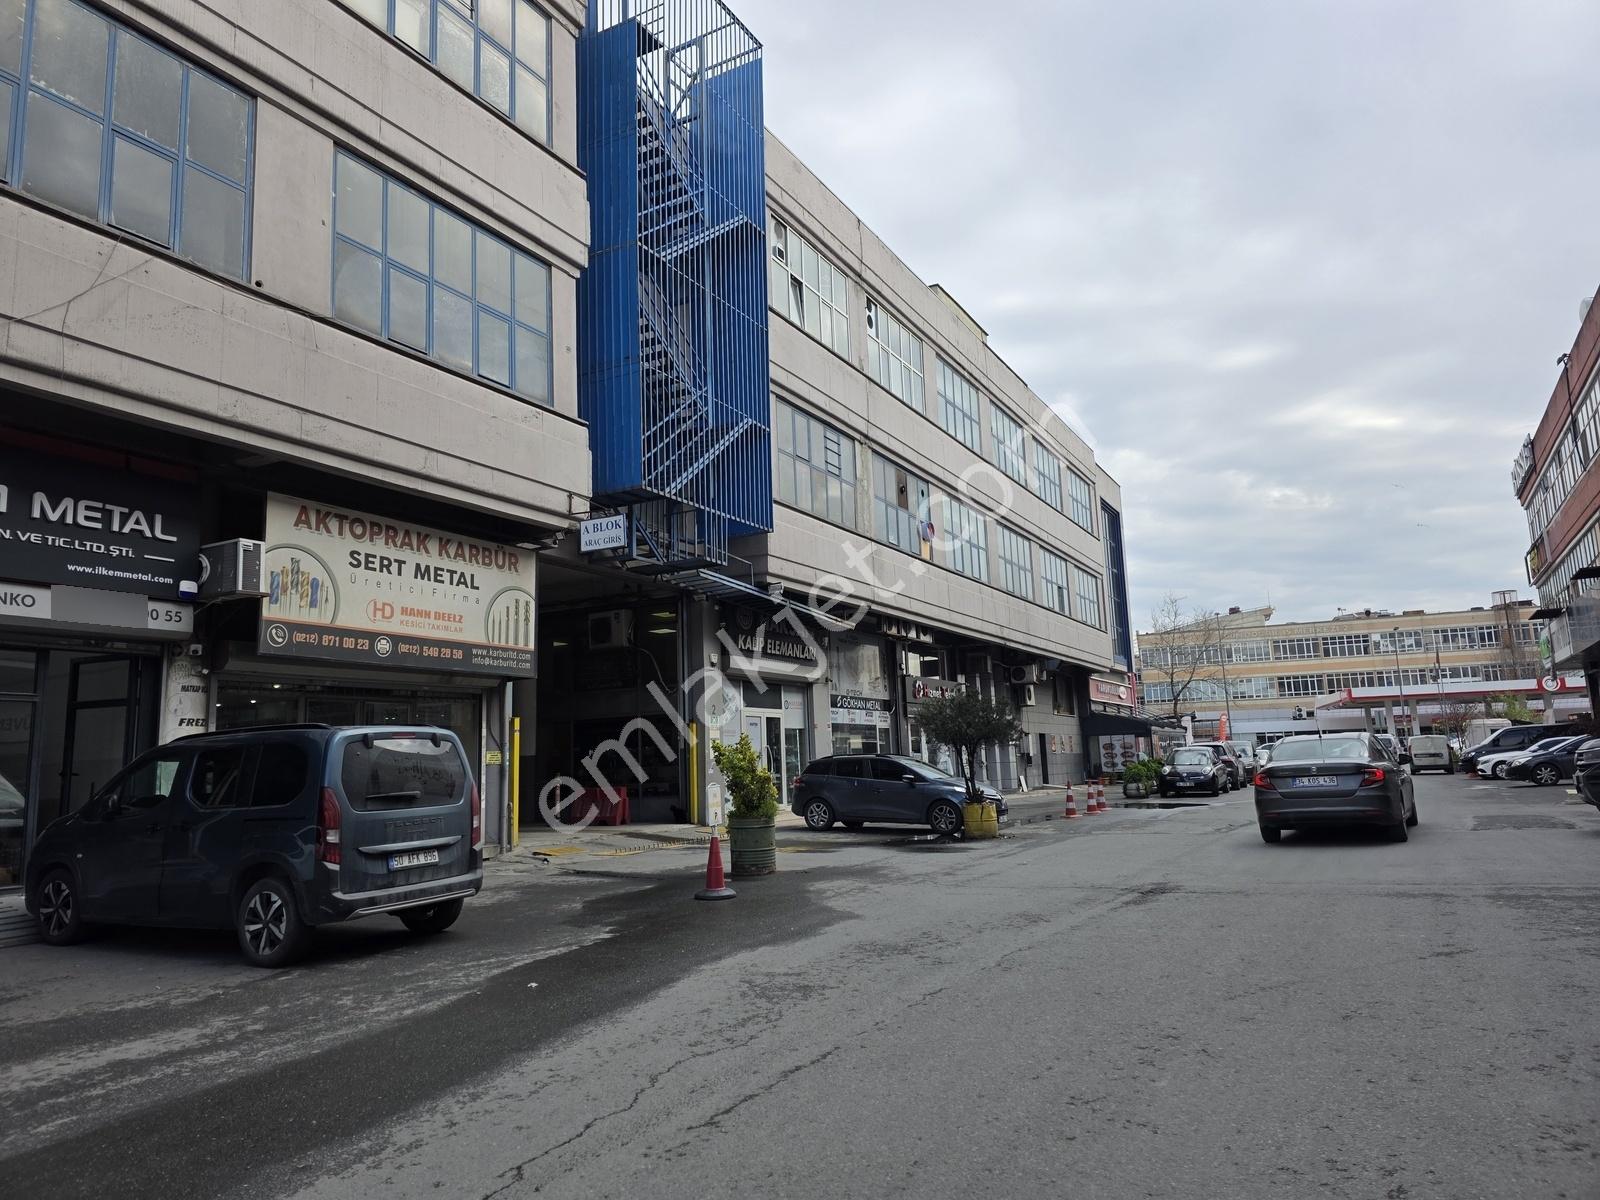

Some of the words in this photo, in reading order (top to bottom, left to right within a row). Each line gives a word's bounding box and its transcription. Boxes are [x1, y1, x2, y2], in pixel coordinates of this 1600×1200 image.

[31, 491, 177, 541] METAL
[16, 530, 42, 544] VE
[582, 525, 590, 535] A
[592, 519, 622, 533] BLOK
[293, 504, 431, 556] AKTOPRAK
[438, 536, 520, 574] KARBÜR
[67, 563, 173, 585] www.ilkemmetal.com
[348, 550, 407, 577] SERT
[413, 562, 480, 591] METAL
[164, 609, 183, 623] 55
[292, 630, 319, 646] (0212)
[343, 637, 355, 649] 00
[357, 638, 369, 650] 23
[398, 642, 420, 656] (0212)
[766, 639, 817, 660] ELEMANLARI
[842, 696, 866, 710] GÖKHAN
